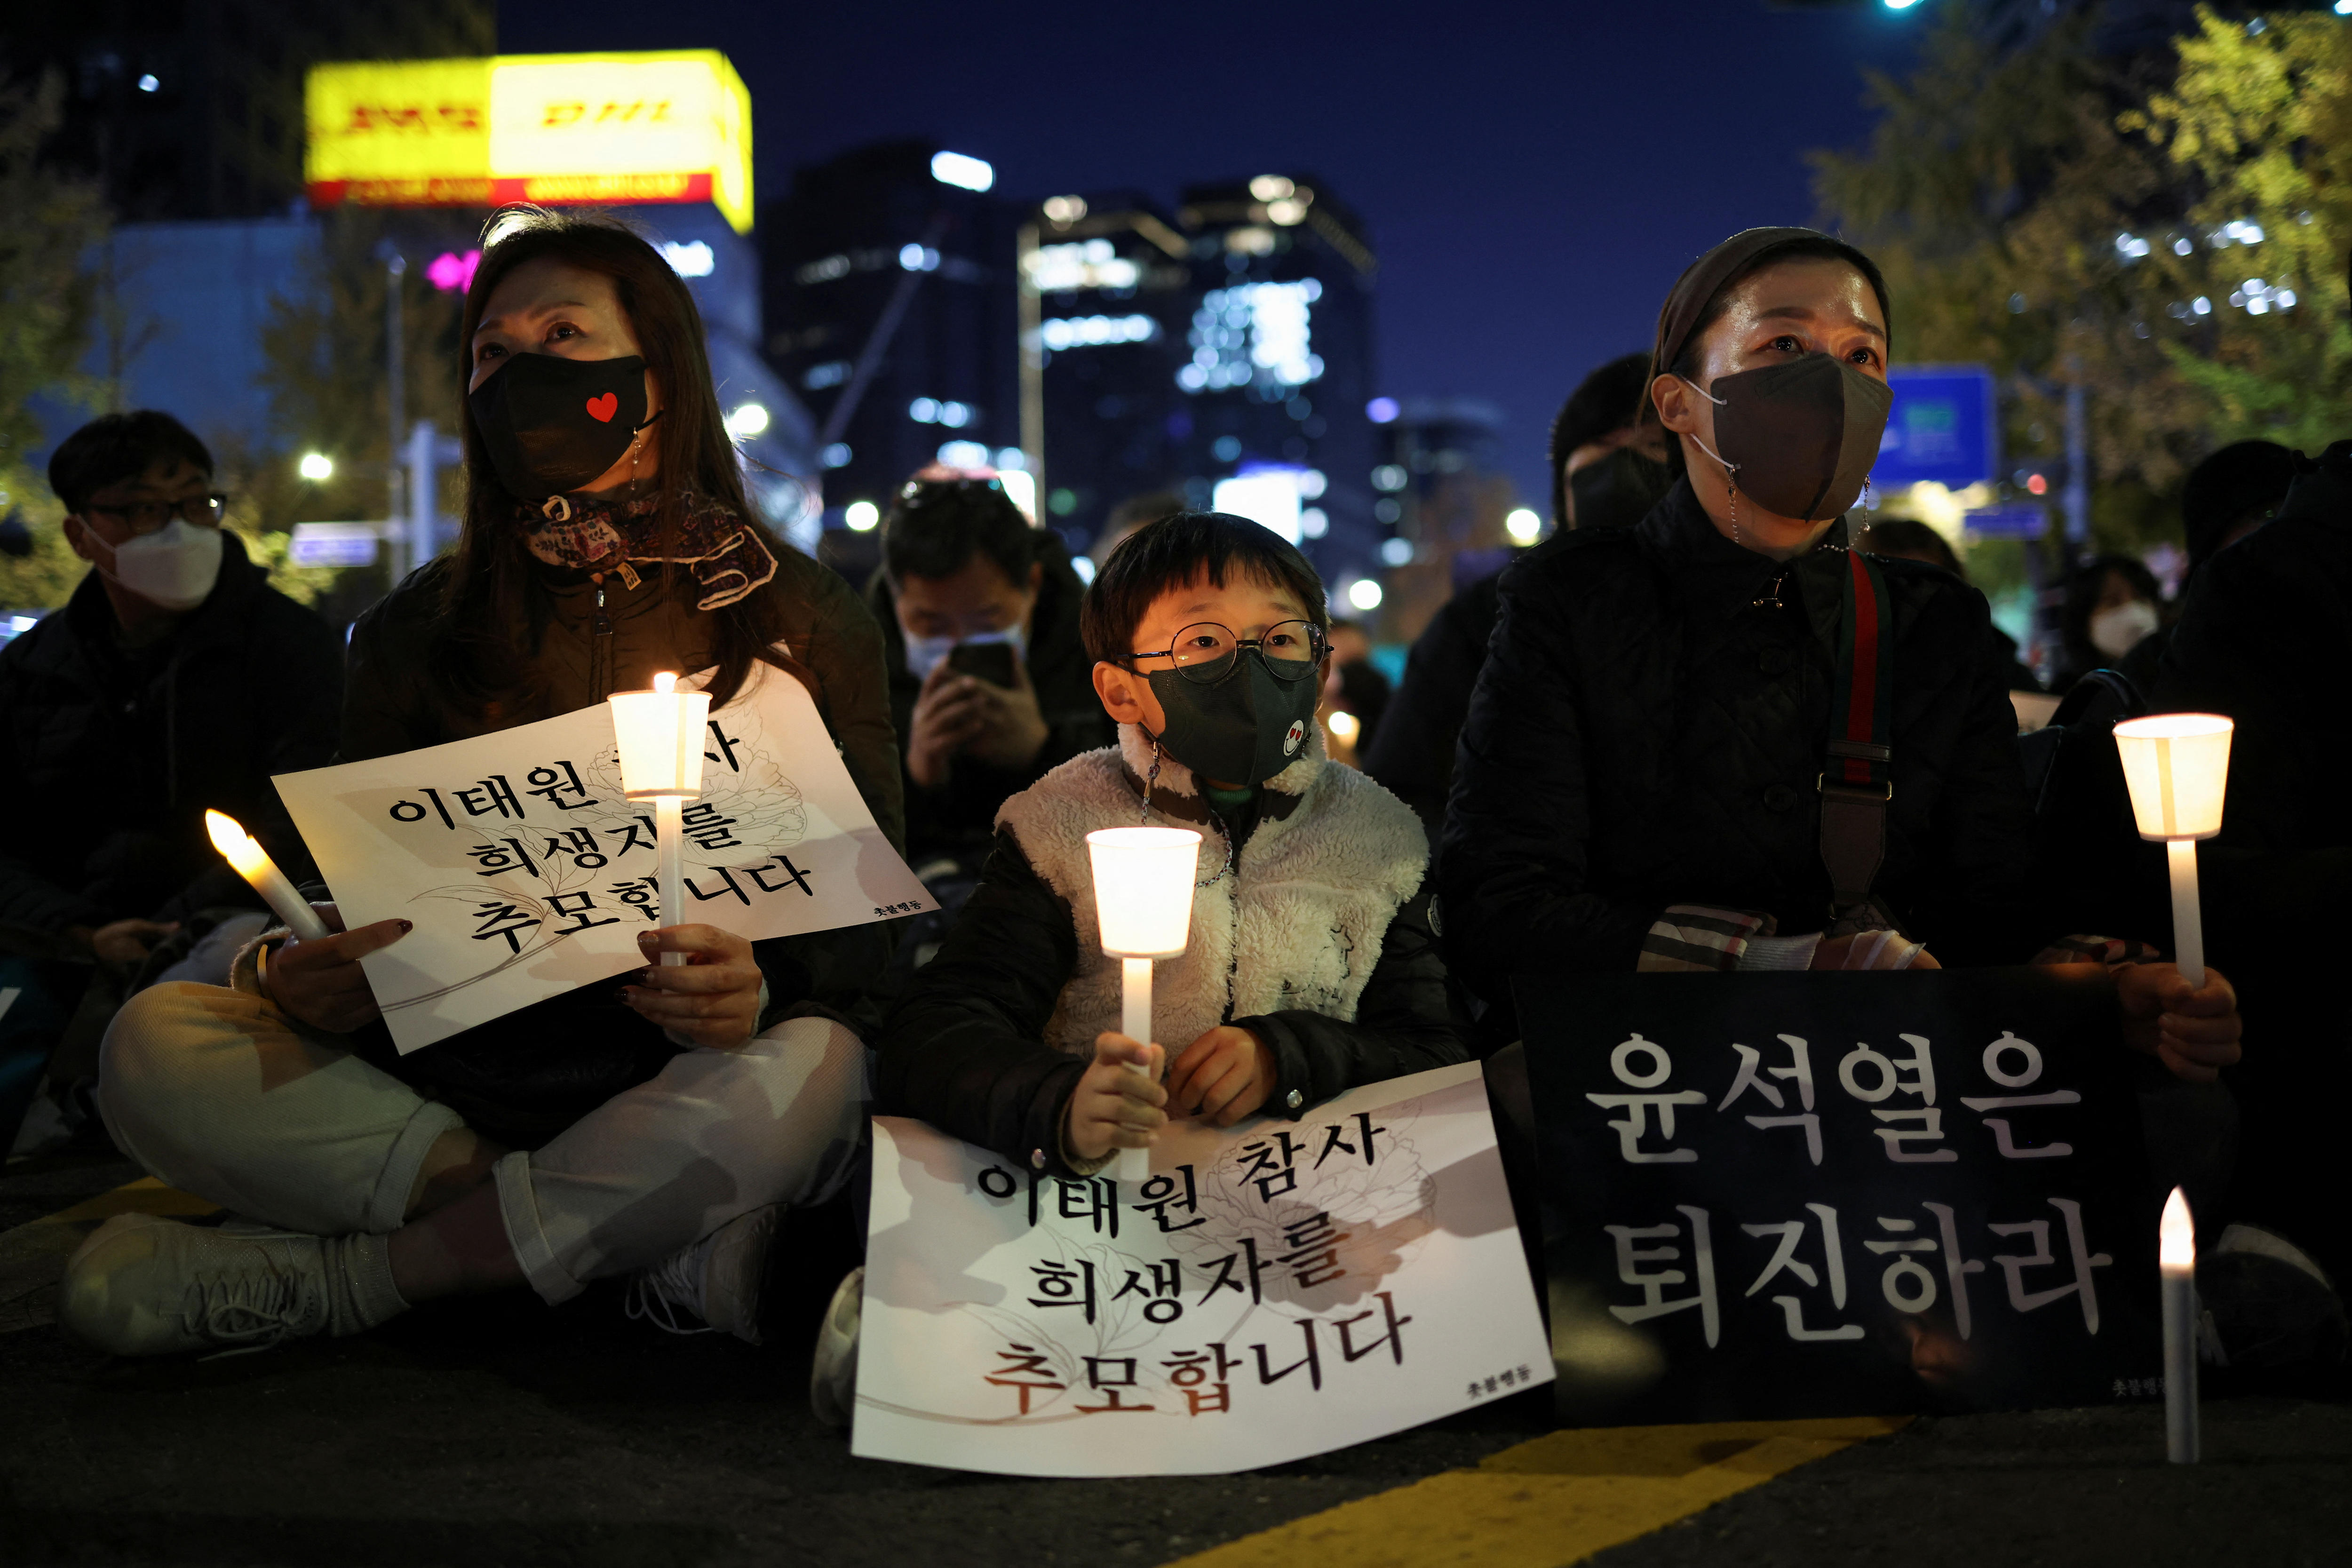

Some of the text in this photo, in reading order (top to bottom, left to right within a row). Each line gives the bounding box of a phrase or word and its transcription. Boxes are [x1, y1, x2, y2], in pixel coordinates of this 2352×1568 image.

[389, 760, 599, 830] 이태원
[466, 803, 742, 878] 희생자를
[471, 855, 813, 954] 추모합니다
[874, 900, 922, 917] 촛불행동
[1585, 1030, 2081, 1166] 윤석열은
[977, 1112, 1386, 1239] 이태원 참사
[1028, 1212, 1349, 1324] 희생자를
[1604, 1198, 2113, 1349] 퇴진하라
[984, 1291, 1412, 1416] 추모합니다
